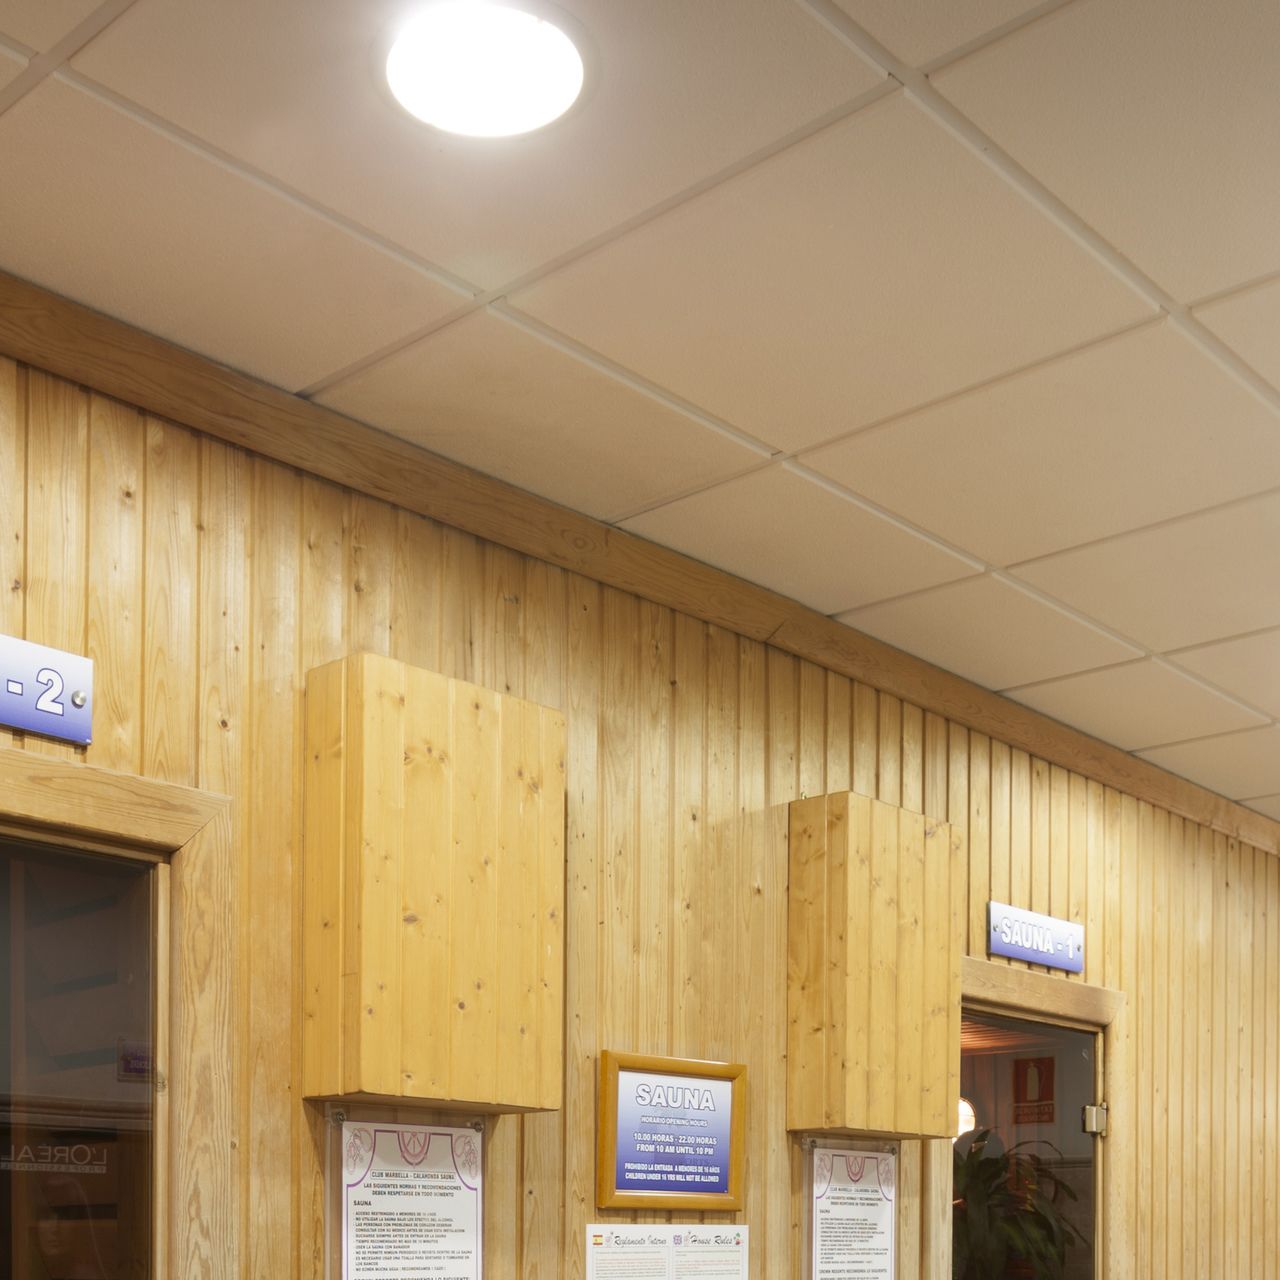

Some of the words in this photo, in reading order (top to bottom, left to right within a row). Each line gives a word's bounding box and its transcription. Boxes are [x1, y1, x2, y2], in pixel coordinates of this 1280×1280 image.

[6, 679, 23, 696] -
[35, 668, 64, 716] 2
[1001, 917, 1054, 954] SAUNA
[1065, 934, 1074, 959] 1
[636, 1083, 715, 1111] SAUNA
[641, 1116, 665, 1125] HORARIO
[666, 1117, 689, 1126] OPENING
[690, 1119, 708, 1127] HOURS
[652, 1133, 674, 1143] HORAS
[679, 1135, 695, 1144] 22.00
[696, 1136, 717, 1145] HORAS
[636, 1144, 655, 1152] FROM
[656, 1145, 664, 1153] 10
[665, 1145, 675, 1153] AM
[676, 1146, 695, 1154] UNTIL
[696, 1146, 703, 1154] 10
[704, 1147, 714, 1155] PM
